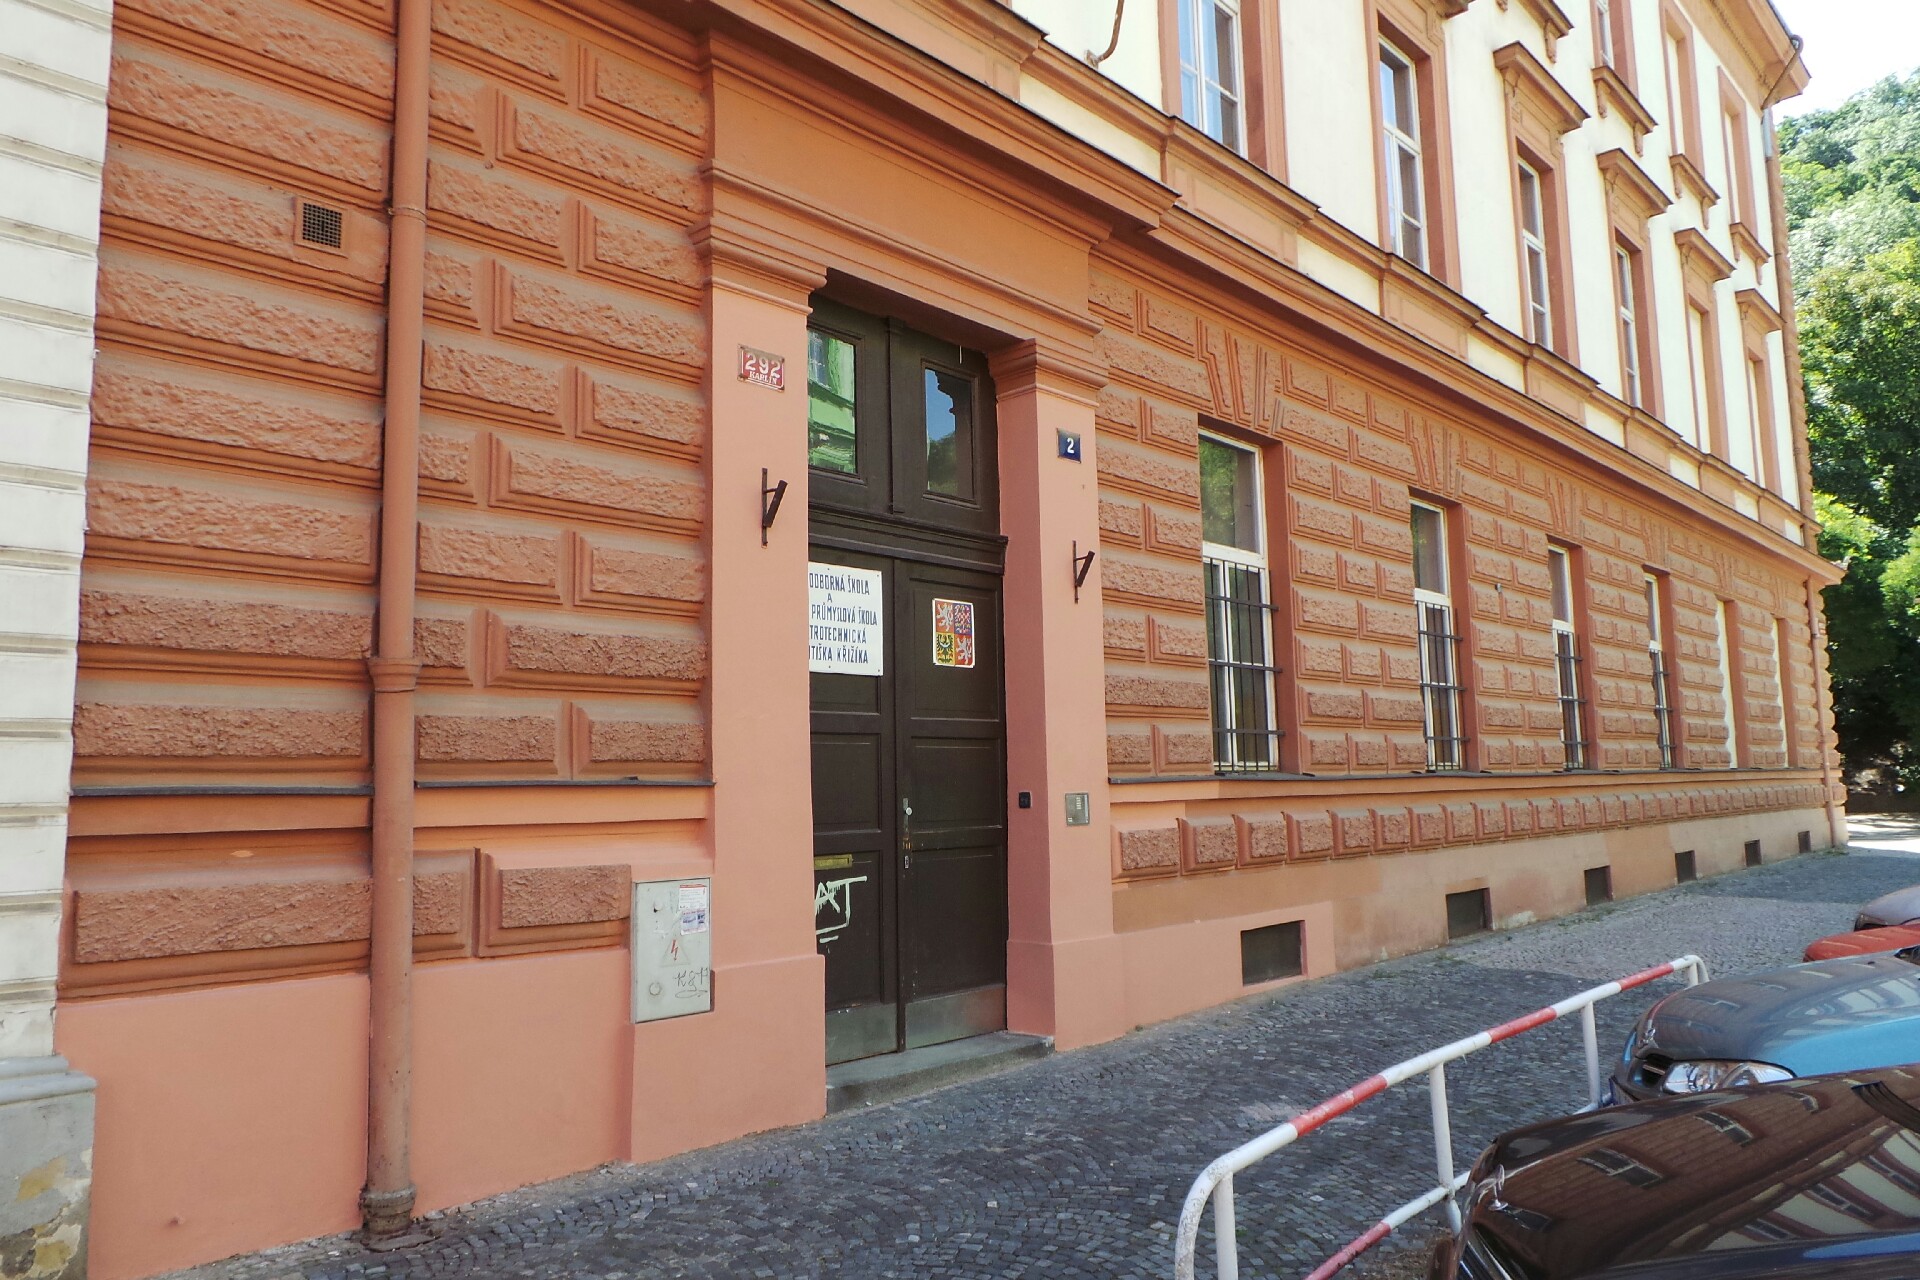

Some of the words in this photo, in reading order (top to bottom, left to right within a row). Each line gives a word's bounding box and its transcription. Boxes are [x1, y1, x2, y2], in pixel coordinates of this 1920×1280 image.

[745, 352, 781, 379] 292
[1066, 437, 1075, 454] 2
[809, 573, 846, 592] ODBORNÁ
[847, 575, 870, 595] ŠKOLA
[827, 593, 833, 603] A
[811, 602, 856, 624] PRŮMYSLOVÁ
[858, 606, 878, 626] ŠKOLA
[836, 645, 869, 664] KŘIŽÍKA
